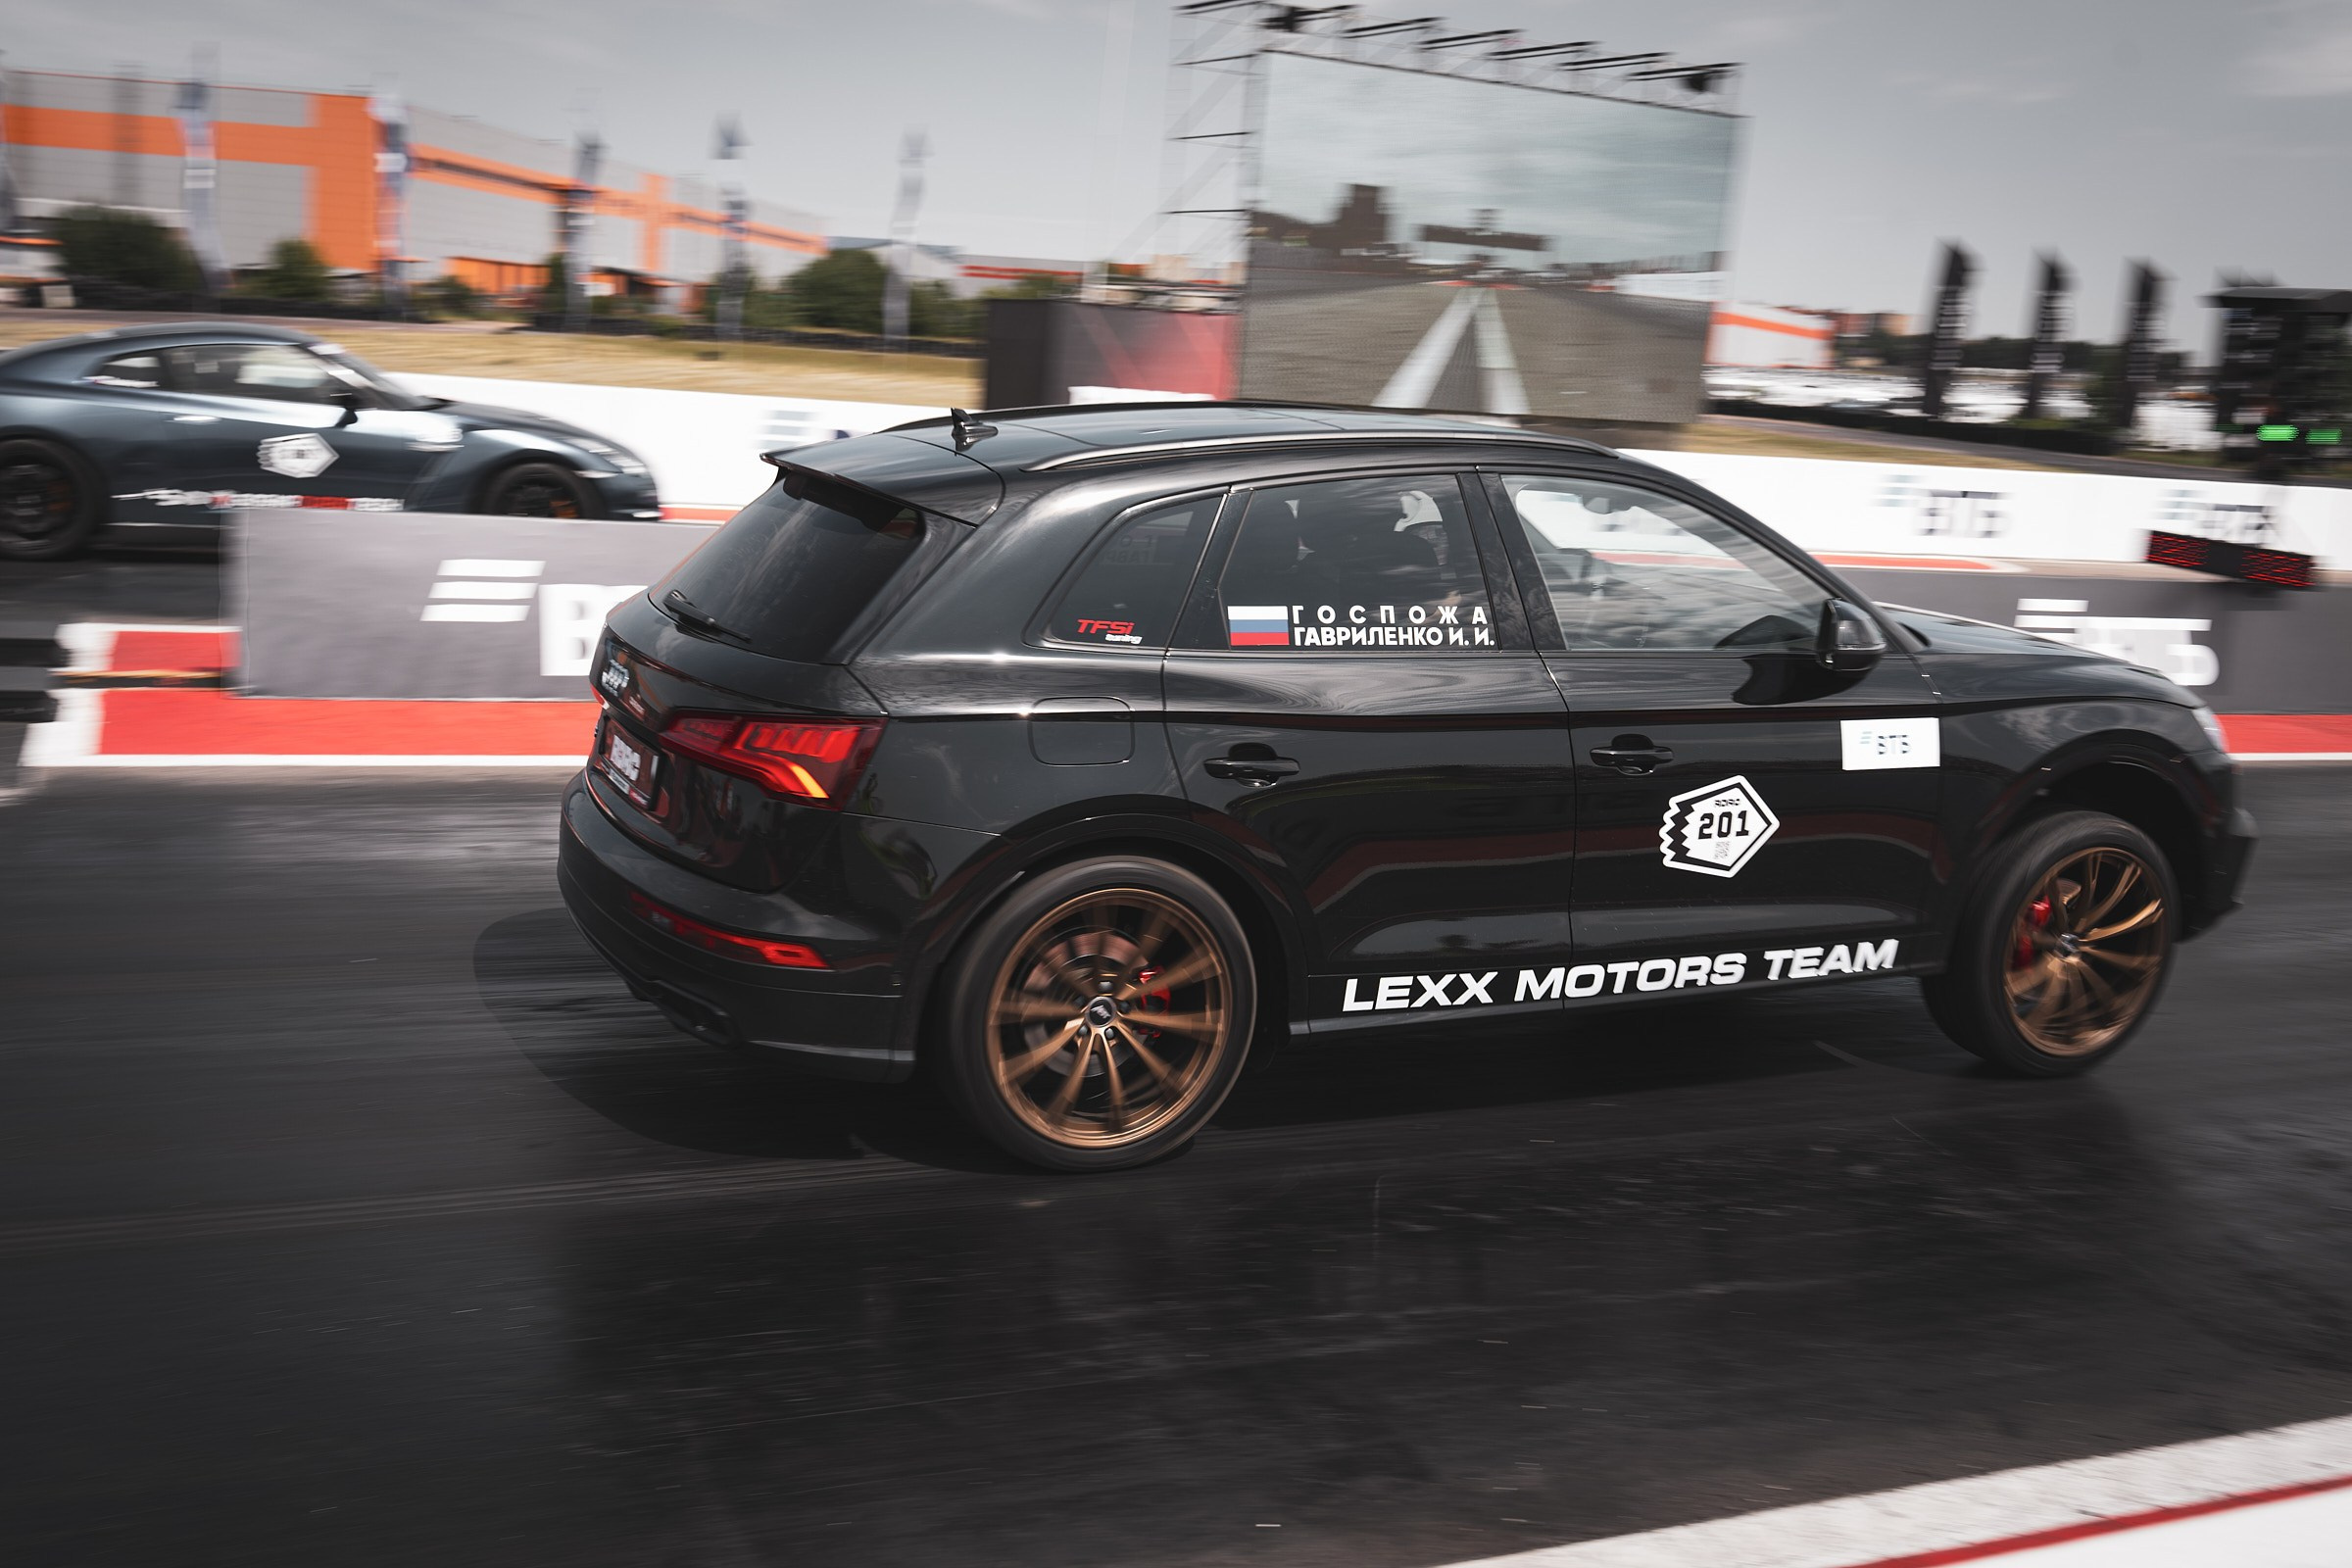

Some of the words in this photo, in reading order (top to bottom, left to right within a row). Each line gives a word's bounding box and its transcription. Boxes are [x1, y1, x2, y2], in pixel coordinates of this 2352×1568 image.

[1292, 605, 1489, 625] ГОСПОЖА
[1294, 626, 1444, 647] ГАВРИЛЕНКО
[1697, 809, 1749, 840] 201
[1342, 971, 1498, 1012] LEXX
[1513, 952, 1747, 1003] MOTORS
[1763, 938, 1899, 981] TEAM
